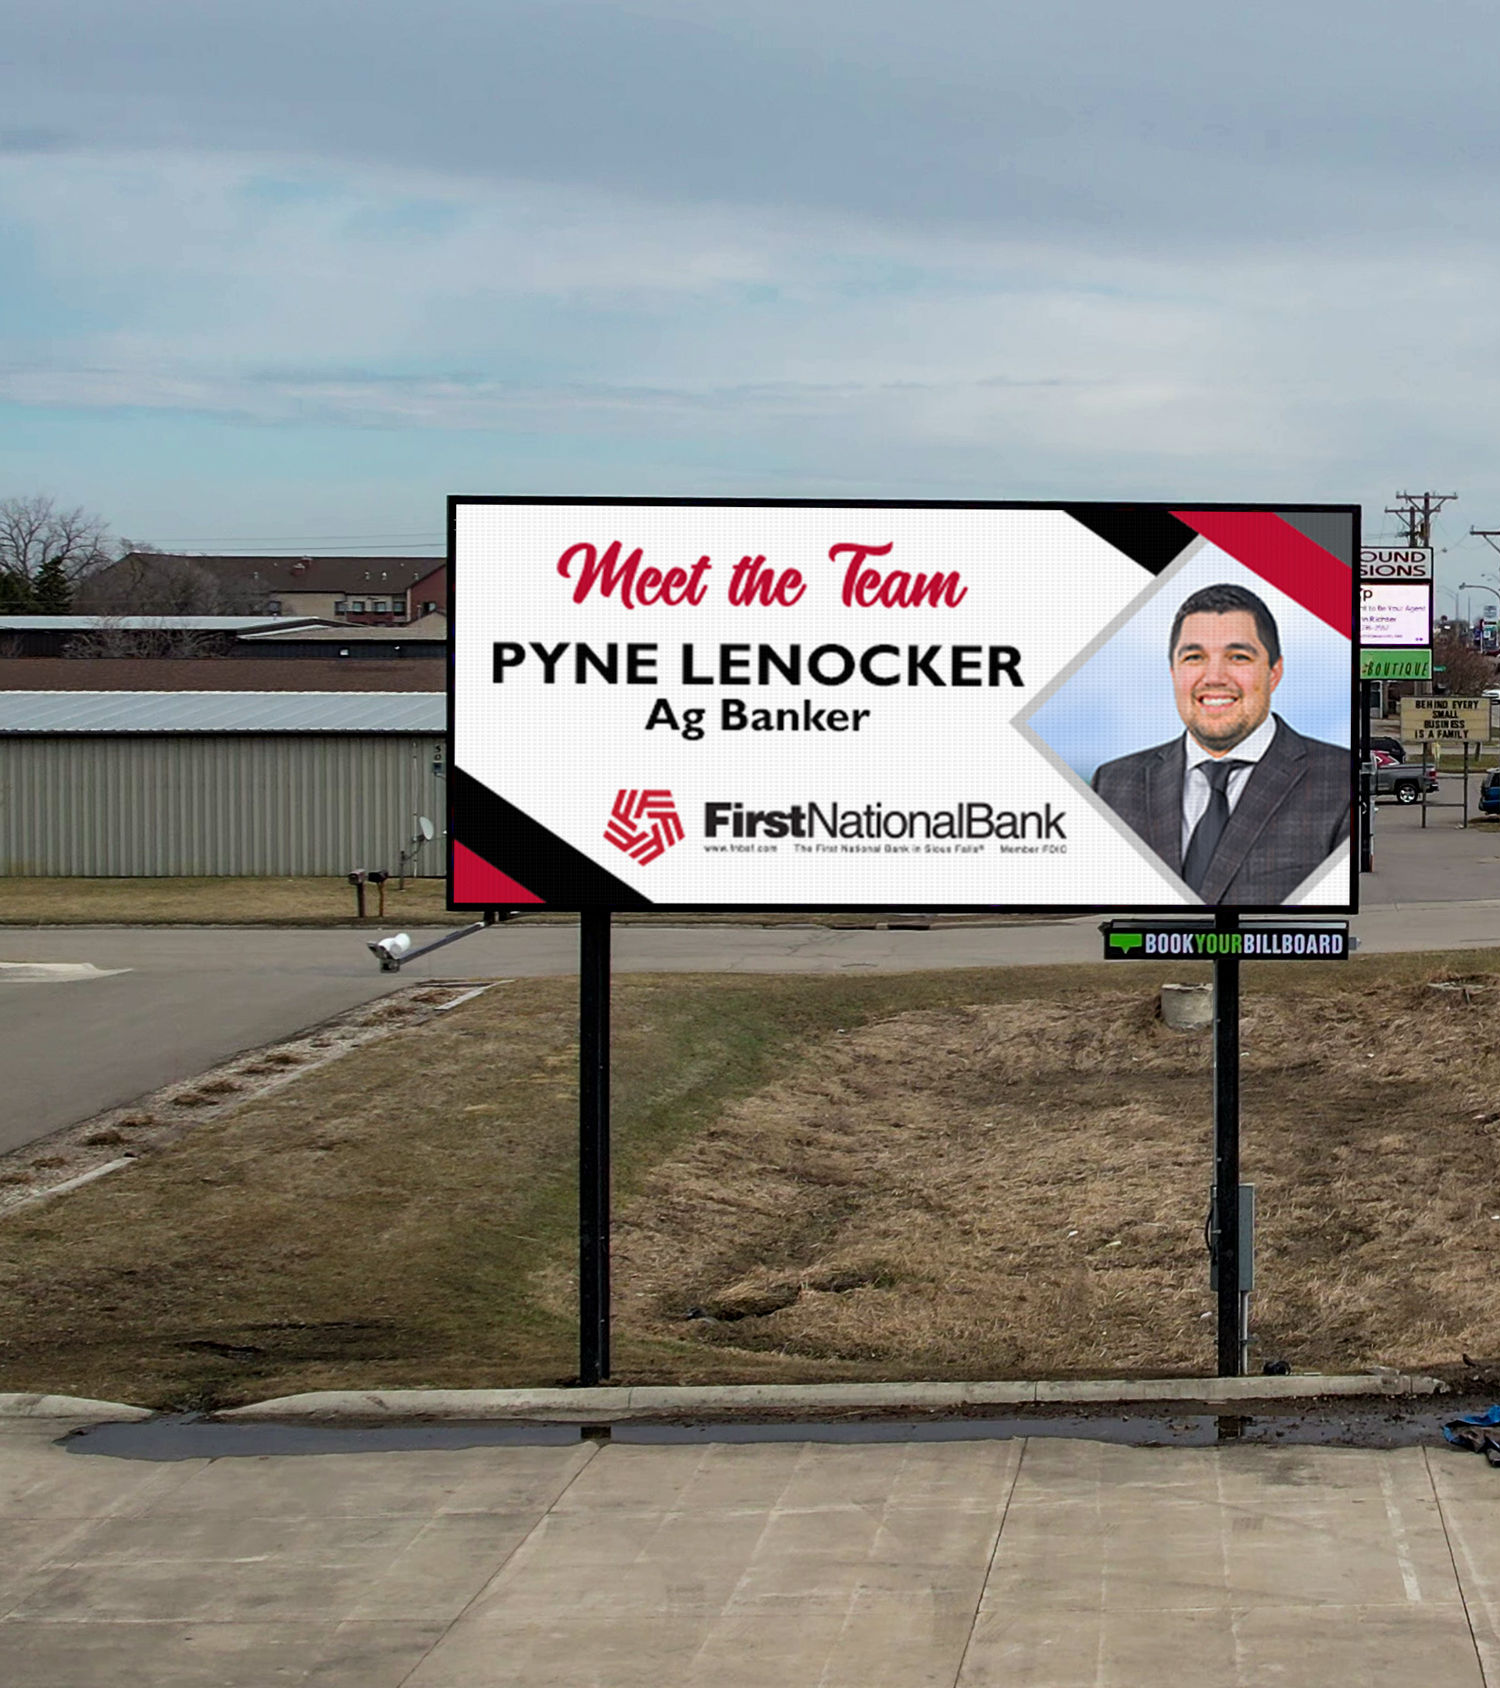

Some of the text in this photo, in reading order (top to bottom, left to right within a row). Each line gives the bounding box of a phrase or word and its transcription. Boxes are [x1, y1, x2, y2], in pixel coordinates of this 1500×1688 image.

[557, 540, 969, 610] Meet the Team
[492, 641, 1025, 688] PYNE LENOCKER
[1367, 661, 1429, 676] BOUTIQUE
[1415, 700, 1479, 709] BEHIND EVERY
[644, 697, 871, 741] Ag Banker
[1432, 710, 1458, 718] SMALL
[1424, 720, 1465, 729] BUSINESS
[1415, 730, 1469, 739] IS A FAMILY
[704, 801, 1067, 840] FirstNationalBank
